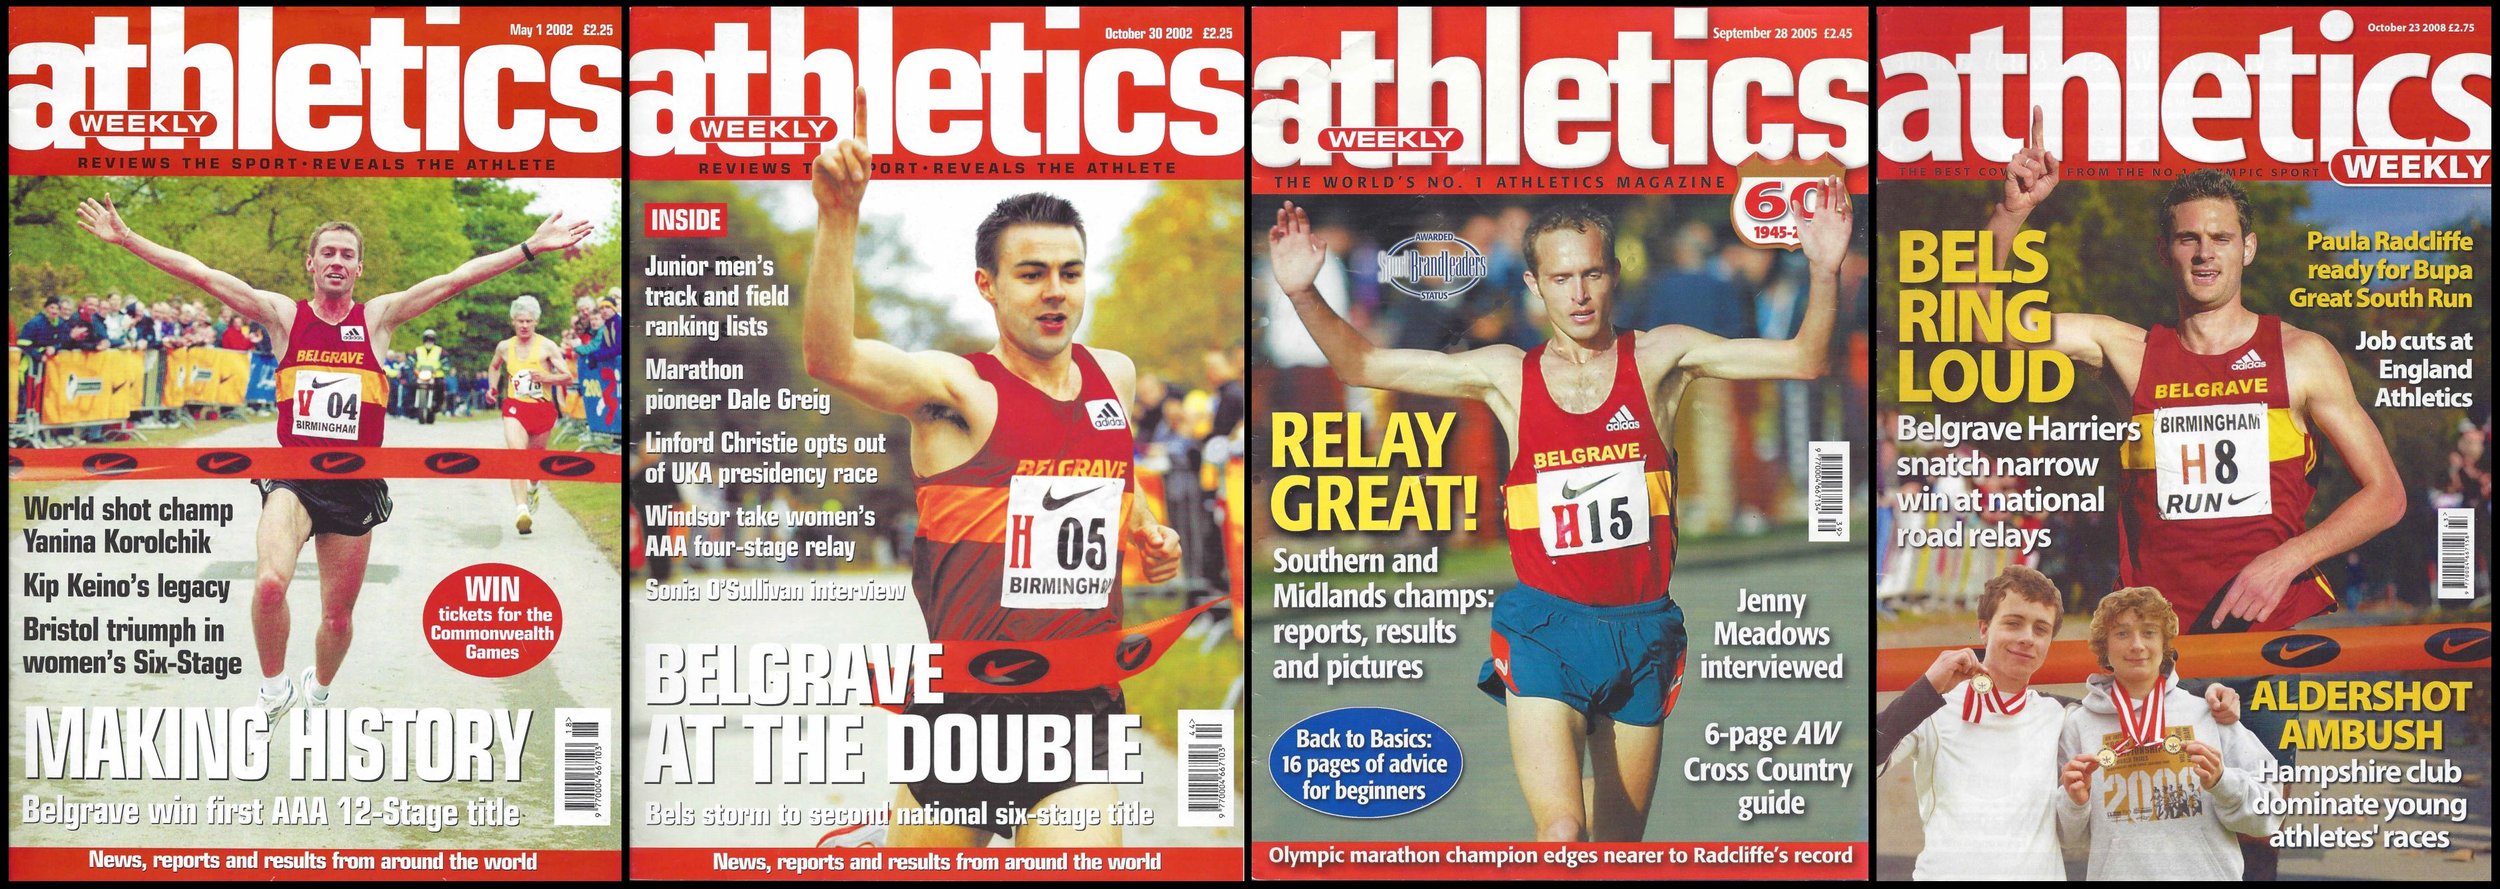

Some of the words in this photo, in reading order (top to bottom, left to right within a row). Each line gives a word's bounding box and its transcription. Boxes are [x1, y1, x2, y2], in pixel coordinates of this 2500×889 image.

[510, 23, 531, 38] May
[536, 24, 541, 36] 1
[546, 24, 573, 36] 2002
[583, 24, 613, 36] £2.25
[1105, 28, 1146, 40] October
[1150, 28, 1162, 39] 30
[1166, 28, 1192, 39] 2002
[1203, 28, 1233, 40] £2.25
[1713, 27, 1771, 42] September
[1776, 28, 1787, 39] 28
[1791, 28, 1817, 39] 2005
[1824, 28, 1852, 39] £2.45
[2368, 23, 2406, 33] October
[2409, 23, 2420, 32] 23
[2422, 23, 2446, 32] 2008
[2448, 23, 2474, 32] £2.75
[9, 6, 622, 153] athletics
[629, 6, 1244, 158] athletics
[1252, 6, 1869, 170] athletics
[1878, 6, 2492, 164] athletics
[79, 115, 208, 132] WEEKLY
[700, 121, 829, 138] WEEKLY
[1328, 130, 1455, 148] WEEKLY
[78, 157, 171, 169] REVIEWS
[183, 158, 220, 169] THE
[417, 158, 455, 171] THE
[467, 158, 556, 171] ATHLETE
[2343, 155, 2490, 179] WEEKLY
[1275, 176, 1312, 189] THE
[1427, 176, 1462, 189] NO.
[1476, 176, 1482, 189] 1
[1497, 176, 1604, 189] ATHLETICS
[1617, 176, 1725, 189] MAGAZINE
[652, 210, 720, 230] INSIDE
[1415, 232, 1454, 241] AWARDED
[2308, 232, 2371, 251] Paula
[2375, 230, 2473, 251] Radcliffe
[645, 255, 709, 279] Junior
[1901, 229, 2048, 284] BELS
[2308, 262, 2373, 284] ready
[2377, 259, 2410, 280] for
[2415, 261, 2473, 284] Bupa
[645, 285, 697, 306] track
[703, 285, 740, 306] and
[746, 284, 788, 306] field
[1421, 291, 1448, 300] STATUS
[2290, 288, 2351, 309] Great
[2356, 288, 2423, 309] South
[2429, 289, 2473, 309] Run
[646, 315, 719, 340] ranking
[726, 315, 768, 337] lists
[1901, 289, 2051, 344] RING
[2356, 331, 2395, 351] Job
[2401, 333, 2446, 351] cuts
[2450, 333, 2472, 351] at
[297, 350, 364, 364] BELGRAVE
[646, 359, 743, 379] Marathon
[2231, 360, 2267, 370] adidas
[1901, 349, 2074, 404] LOUD
[2379, 360, 2472, 384] England
[2155, 378, 2269, 399] BELGRAVE
[2375, 388, 2472, 408] Athletics
[298, 390, 314, 416] V
[327, 392, 358, 420] 04
[646, 390, 721, 413] pioneer
[727, 389, 771, 410] Dale
[778, 389, 830, 414] Greig
[296, 420, 356, 434] BIRMINGHAM
[1095, 418, 1125, 427] adidas
[1606, 420, 1640, 431] adidas
[1898, 415, 2021, 447] Belgrave
[2028, 415, 2141, 441] Harriers
[2161, 413, 2261, 433] BIRMINGHAM
[1271, 411, 1456, 467] RELAY
[1534, 443, 1640, 468] BELGRAVE
[1897, 453, 1991, 476] snatch
[1997, 457, 2098, 476] narrow
[24, 495, 93, 521] World
[102, 496, 151, 521] shot
[159, 496, 233, 527] champ
[1271, 476, 1477, 532] GREAT!
[1897, 490, 1949, 511] win
[1955, 491, 1982, 511] at
[1989, 487, 2104, 512] national
[2166, 493, 2223, 514] RUN
[24, 528, 95, 554] Yanina
[104, 528, 211, 554] Korolchik
[1009, 514, 1034, 568] H
[1057, 517, 1107, 570] 05
[1898, 523, 1964, 547] road
[1969, 523, 2052, 554] relays
[1274, 548, 1385, 573] Southern
[1393, 548, 1438, 573] and
[24, 574, 58, 603] Kip
[158, 574, 230, 604] legacy
[465, 576, 519, 602] WIN
[1274, 583, 1386, 608] Midlands
[1394, 583, 1494, 615] champs:
[439, 607, 491, 622] tickets
[498, 607, 522, 622] for
[527, 607, 552, 622] the
[1737, 590, 1806, 618] Jenny
[24, 617, 98, 641] Bristol
[107, 618, 196, 647] triumph
[204, 618, 224, 641] in
[431, 626, 554, 641] Commonwealth
[1274, 622, 1368, 650] reports,
[1376, 619, 1457, 644] results
[1714, 621, 1830, 647] Meadows
[134, 649, 242, 680] Six-Stage
[466, 645, 519, 660] Games
[646, 642, 945, 706] BELGRAVE
[1273, 654, 1319, 679] and
[1327, 654, 1423, 685] pictures
[1701, 654, 1843, 679] interviewed
[2250, 681, 2472, 712] ALDERSHOT
[26, 705, 269, 780] MAKING
[290, 708, 534, 782] HISTORY
[1297, 728, 1344, 749] Back
[1349, 730, 1366, 749] to
[1371, 728, 1432, 749] Basics:
[1705, 722, 1786, 752] 6-page
[1793, 721, 1842, 745] AW
[2280, 720, 2443, 750] AMBUSH
[644, 713, 725, 785] AT
[742, 713, 865, 785] THE
[889, 713, 1143, 785] DOUBLE
[1283, 755, 1302, 773] 16
[1307, 757, 1361, 778] pages
[1366, 754, 1385, 773] of
[1389, 754, 1447, 773] advice
[1684, 759, 1749, 782] Cross
[1757, 758, 1852, 789] Country
[2260, 759, 2401, 789] Hampshire
[2406, 759, 2462, 784] club
[1303, 780, 1330, 800] for
[1335, 780, 1426, 805] beginners
[1738, 790, 1805, 821] guide
[2252, 794, 2379, 817] dominate
[2384, 799, 2467, 822] young
[2270, 824, 2379, 848] athletes'
[2384, 830, 2450, 848] races
